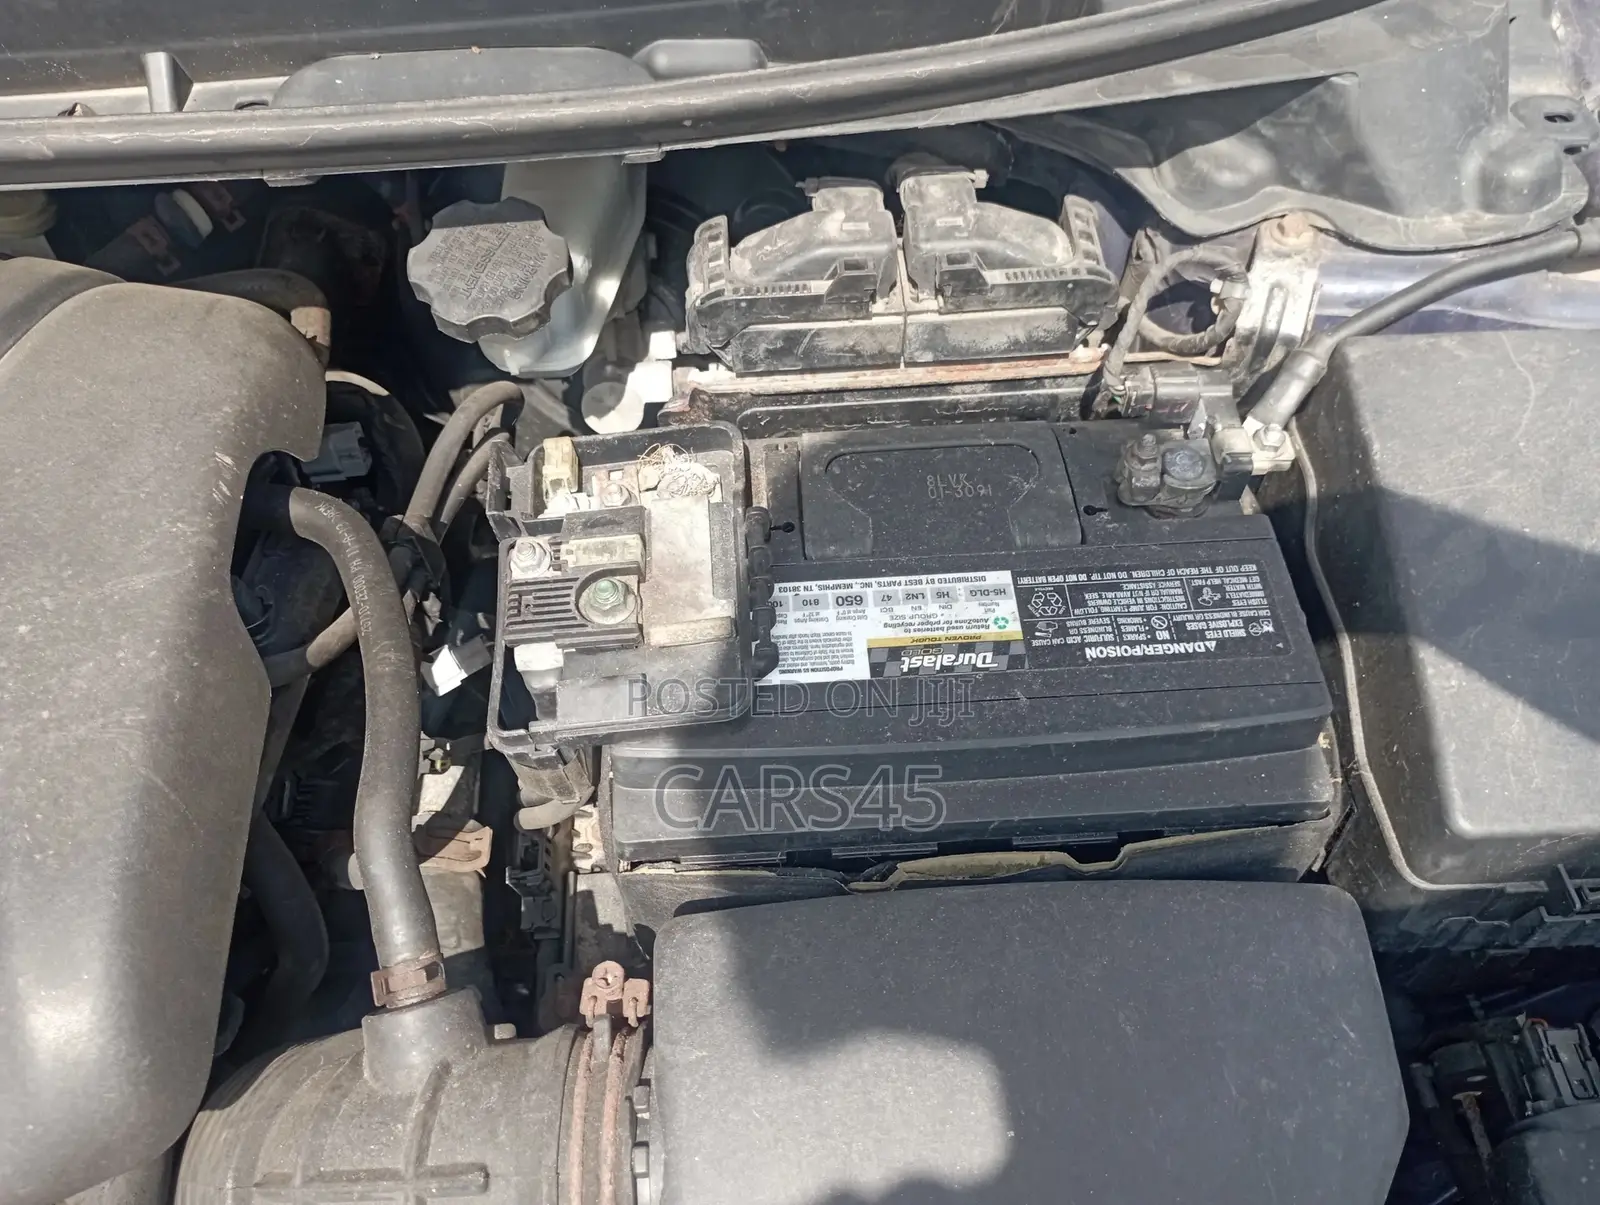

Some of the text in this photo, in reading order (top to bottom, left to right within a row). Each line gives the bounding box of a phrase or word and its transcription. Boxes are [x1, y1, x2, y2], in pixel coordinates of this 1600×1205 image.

[1017, 563, 1258, 585] KEEP OUT OF THE REACH OF CHILDREN. DO NOT TIP. DO NOT OPEN BATTERY!
[904, 578, 923, 587] BEST
[937, 575, 987, 585] DISTRIBUTED
[1222, 576, 1248, 584] MEDICAL
[1249, 575, 1260, 583] GET
[815, 582, 853, 591] MEMPHIS,
[874, 580, 902, 588] PARTS,
[1119, 580, 1181, 591] SERVICE ASSISTANCE.
[905, 592, 925, 600] LN2
[936, 591, 950, 599] H5
[969, 588, 1007, 597] H5-DLG
[1084, 592, 1099, 600] SEEK
[1143, 589, 1150, 597] IF
[1158, 588, 1184, 596] MANUAL
[802, 598, 820, 607] 810
[835, 595, 864, 607] 650
[881, 594, 893, 602] 47
[1143, 595, 1186, 604] INSTRUCTIONS
[1087, 599, 1112, 607] OWNERS
[1145, 603, 1158, 611] FOR
[1159, 602, 1188, 610] CAUTION:
[1231, 599, 1248, 607] EYES
[1073, 607, 1098, 615] FOLLOW
[1128, 604, 1145, 612] JUMP
[908, 612, 938, 620] GROUP
[1203, 611, 1238, 620] BLINDNESS
[1237, 609, 1258, 617] CAUSE
[883, 620, 916, 629] recycling
[916, 618, 941, 627] proper
[953, 617, 990, 626] AutoZone
[1065, 616, 1111, 627] SEVERE BURNS
[1116, 616, 1143, 625] SMOKING
[1185, 618, 1244, 631] EXPLOSIVE GASES
[912, 626, 945, 634] batteries
[1068, 625, 1113, 635] BLINDNESS OR
[1120, 624, 1145, 633] FLAMES
[1122, 633, 1147, 641] SPARKS
[1155, 630, 1170, 640] NO
[1204, 628, 1247, 639] SHIELD EYES
[909, 634, 982, 644] PROVEN TOUGH
[1031, 633, 1115, 647] SULFURIC ACID CAN CAUSE
[900, 647, 944, 656] GOLD
[1084, 641, 1206, 659] DANGER/POISON
[899, 651, 999, 673] Duralast
